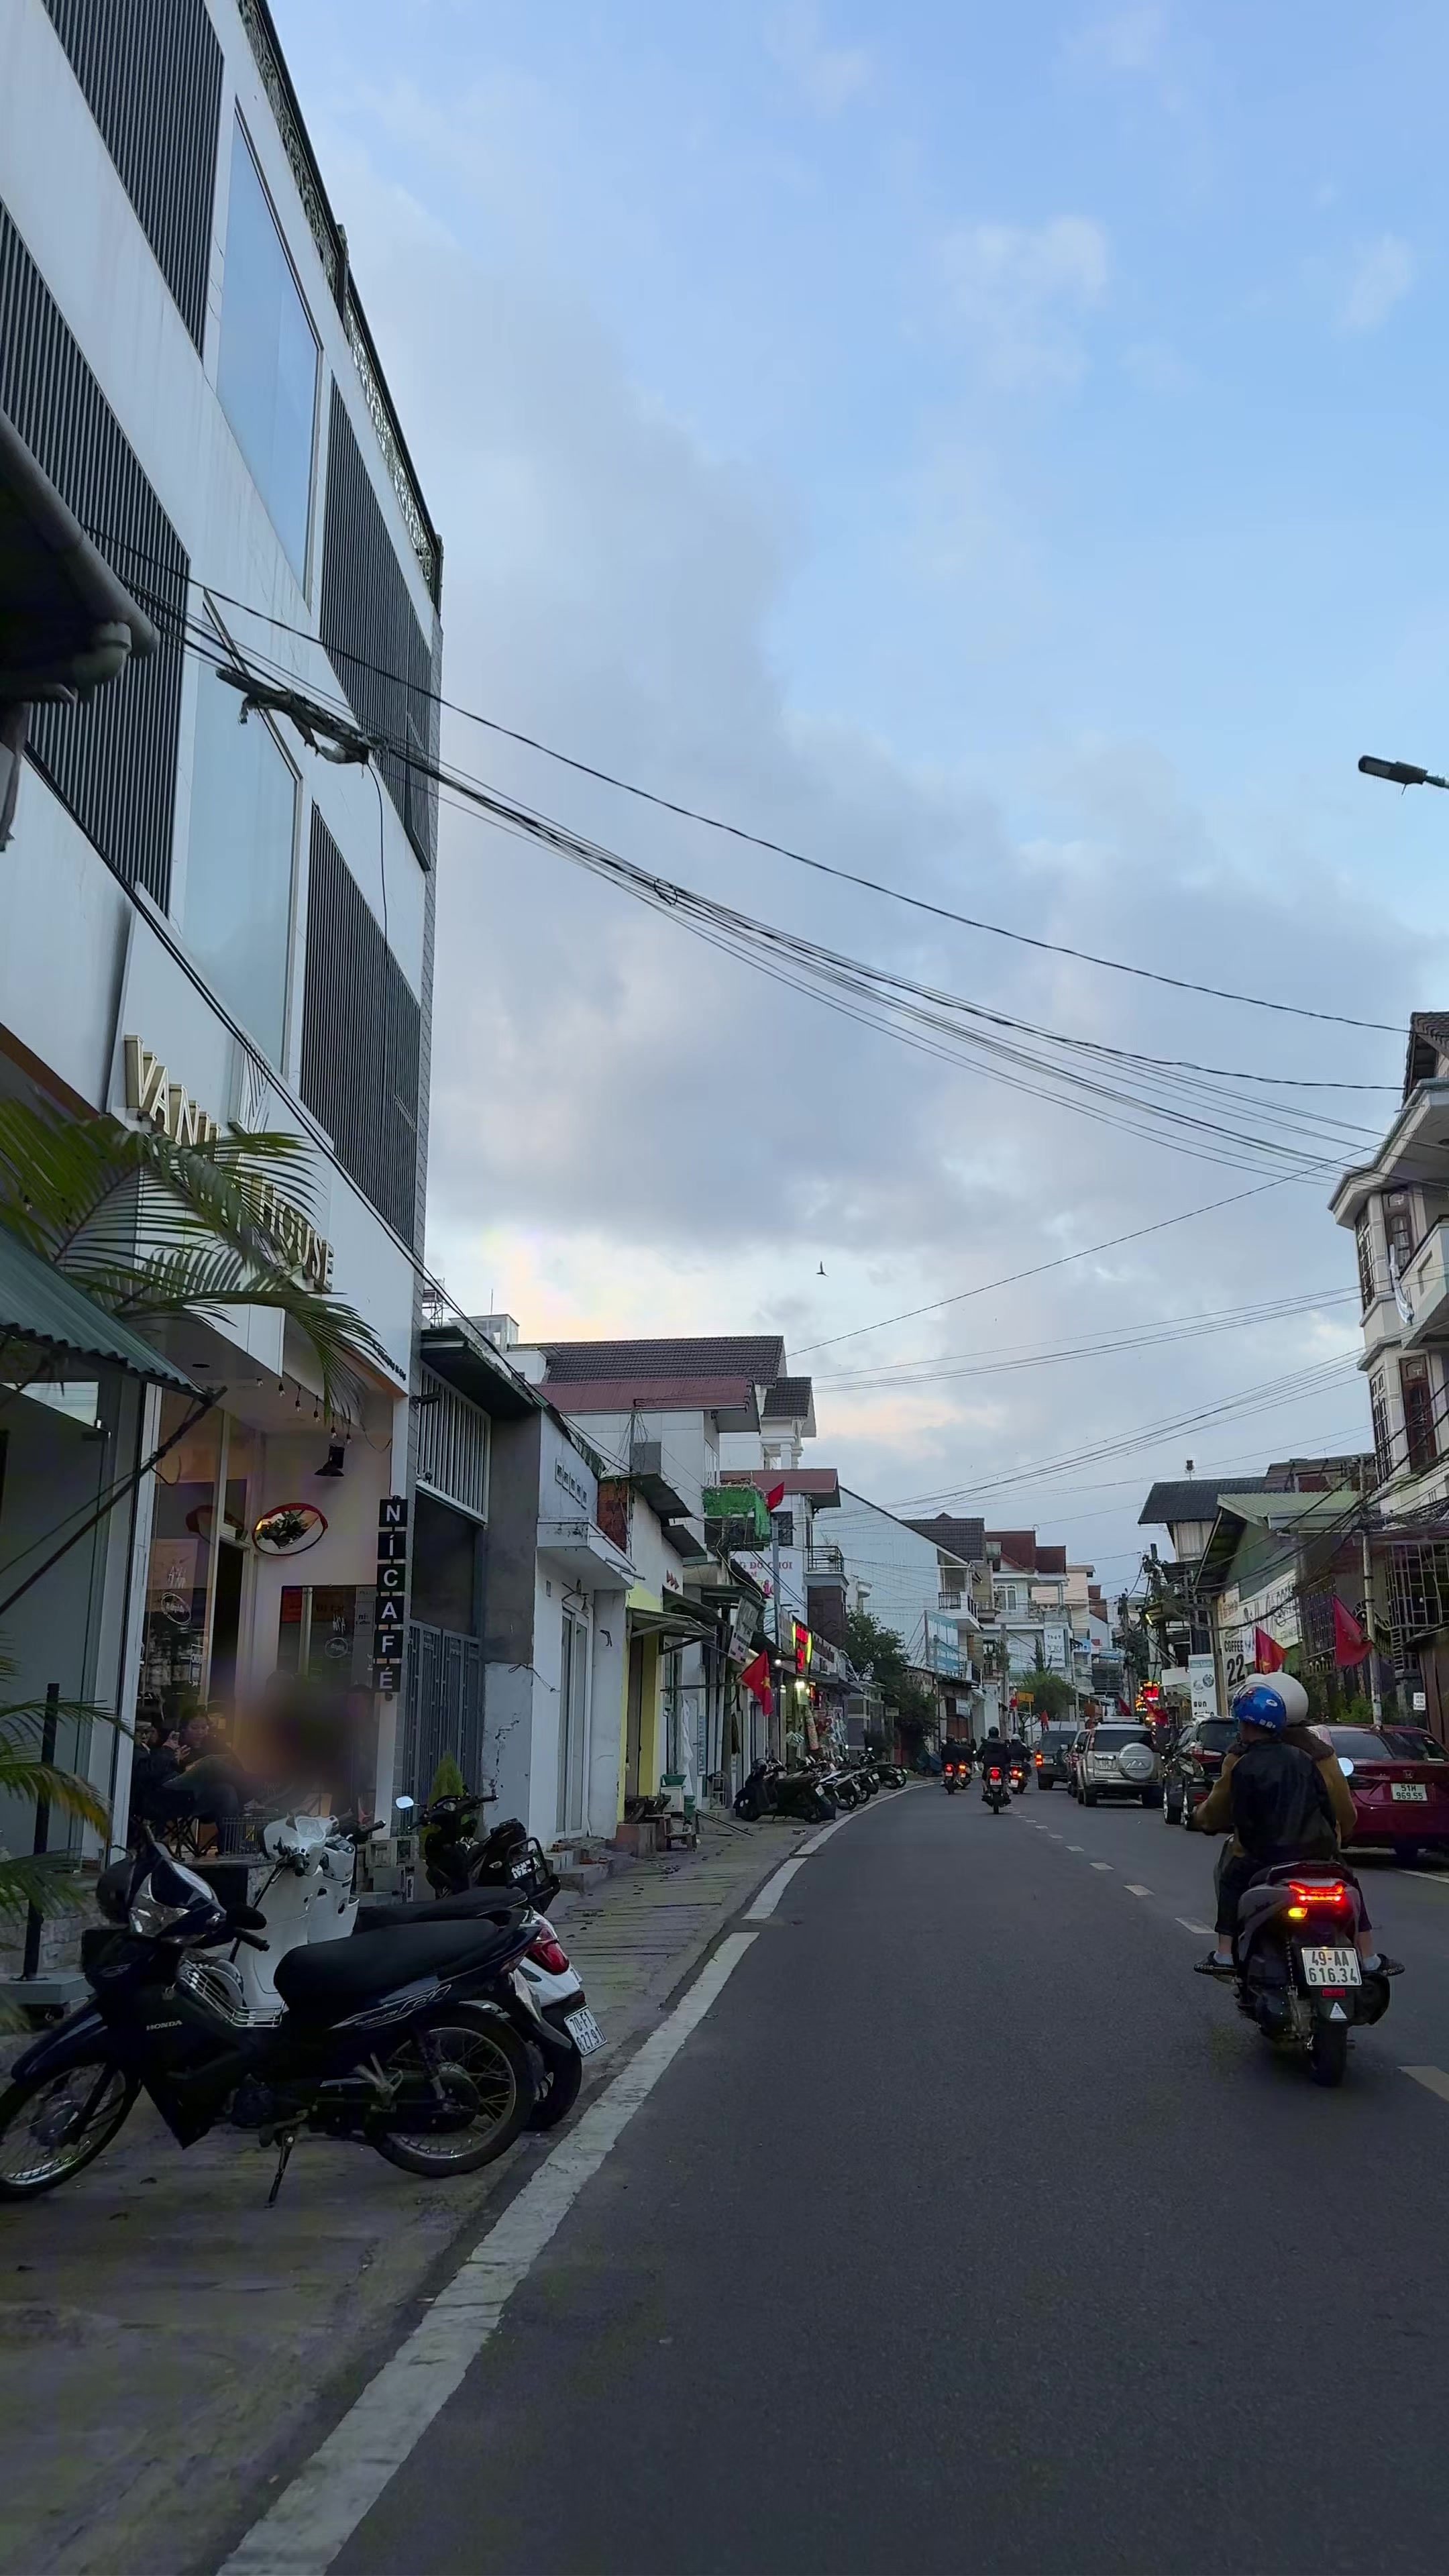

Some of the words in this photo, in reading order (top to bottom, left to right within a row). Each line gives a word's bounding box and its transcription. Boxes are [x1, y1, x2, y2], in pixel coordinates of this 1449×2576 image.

[1224, 1640, 1244, 1652] COFFEE
[1227, 1654, 1245, 1686] 22
[1396, 1792, 1424, 1800] 969.55
[1312, 1951, 1349, 1966] 49-AA
[1309, 1968, 1357, 1983] 616.34
[146, 2020, 182, 2031] HONDA
